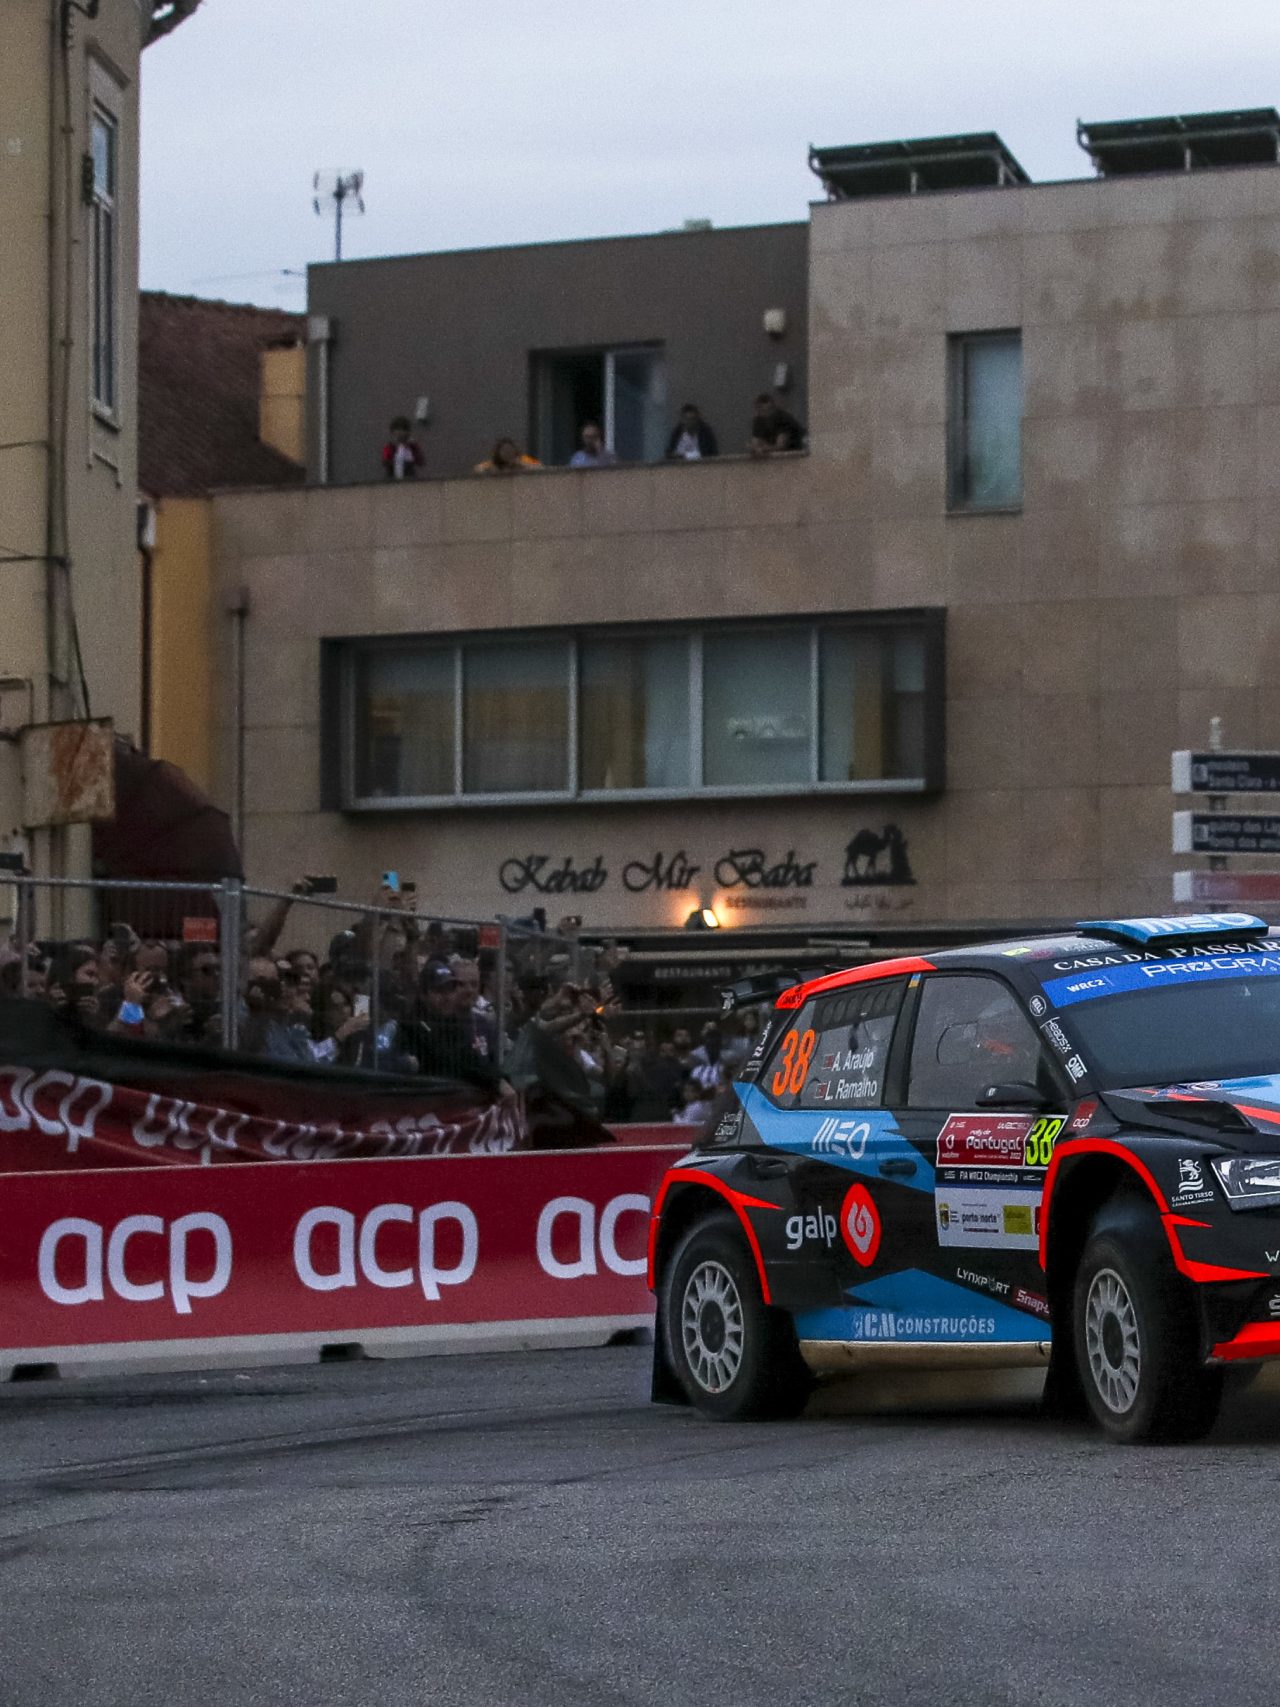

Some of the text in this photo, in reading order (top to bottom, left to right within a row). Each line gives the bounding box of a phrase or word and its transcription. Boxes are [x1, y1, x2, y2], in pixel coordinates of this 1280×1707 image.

[499, 850, 817, 893] Kebab Mir Baba
[1053, 956, 1119, 971] CASA
[1122, 951, 1162, 963] DA
[1066, 978, 1107, 993] WRC2
[772, 1029, 817, 1097] 38
[831, 1047, 875, 1073] A. Araújo
[824, 1078, 878, 1101] L. Ramalho
[965, 1136, 1022, 1154] Portugal
[1026, 1118, 1062, 1166] 38
[535, 1193, 652, 1280] ac
[785, 1205, 838, 1250] galp
[37, 1211, 233, 1315] acp
[293, 1200, 479, 1301] acp
[896, 1314, 995, 1338] CONSTRUÇÕES
